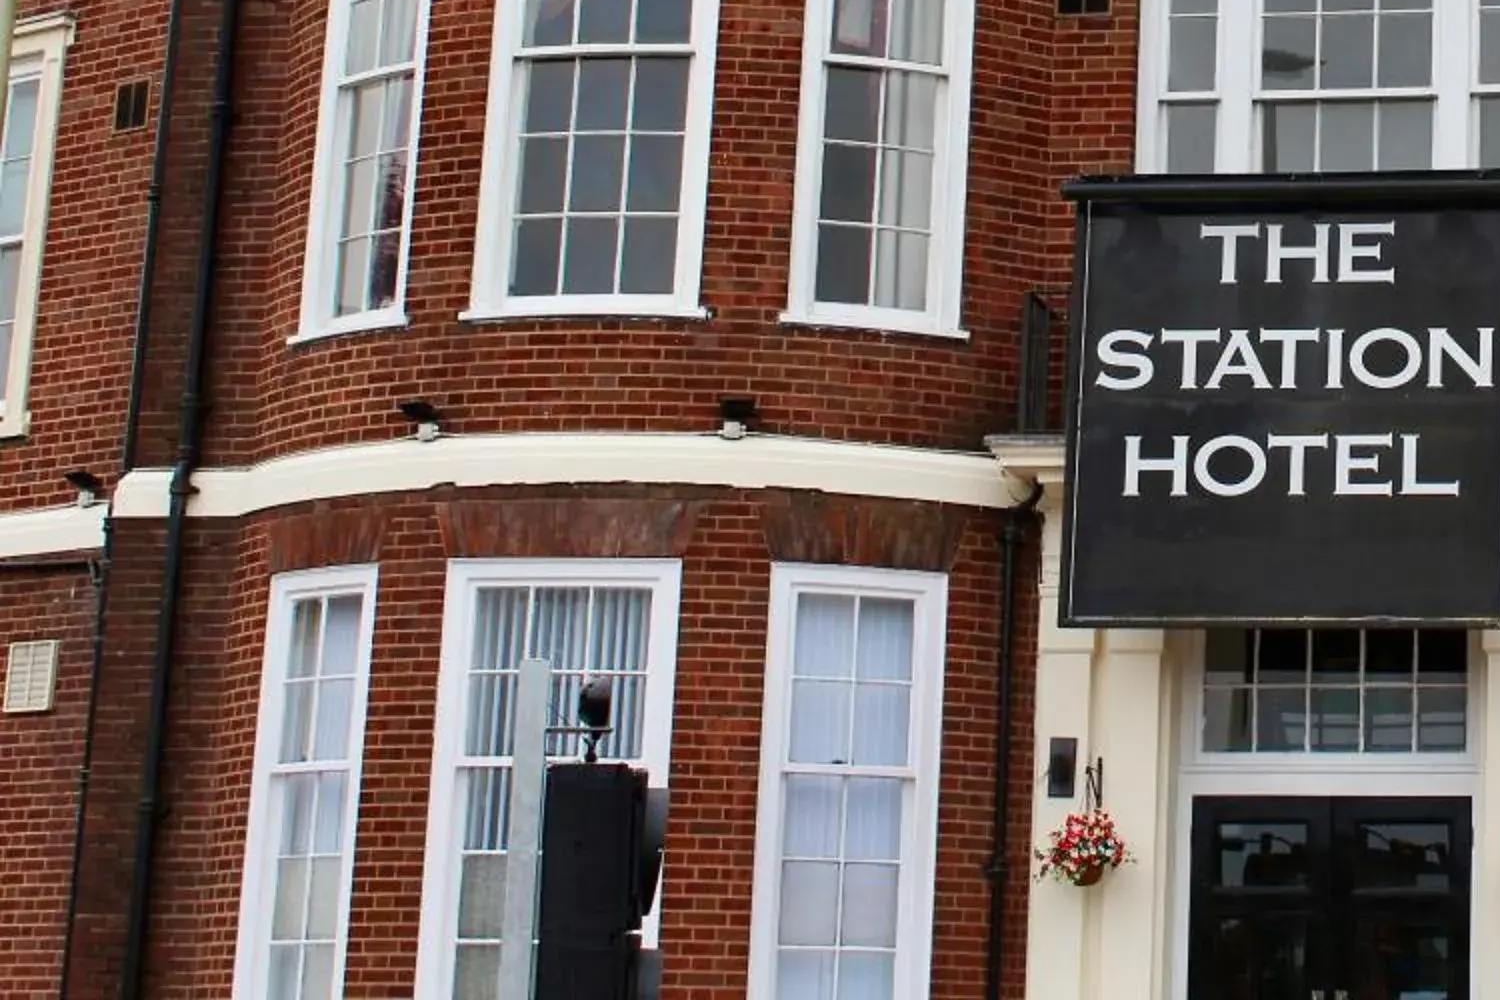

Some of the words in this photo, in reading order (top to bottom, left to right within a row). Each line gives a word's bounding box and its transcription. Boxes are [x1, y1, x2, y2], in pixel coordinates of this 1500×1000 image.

[1200, 220, 1395, 284] THE
[1095, 327, 1495, 390] STATION
[1122, 433, 1460, 497] HOTEL
